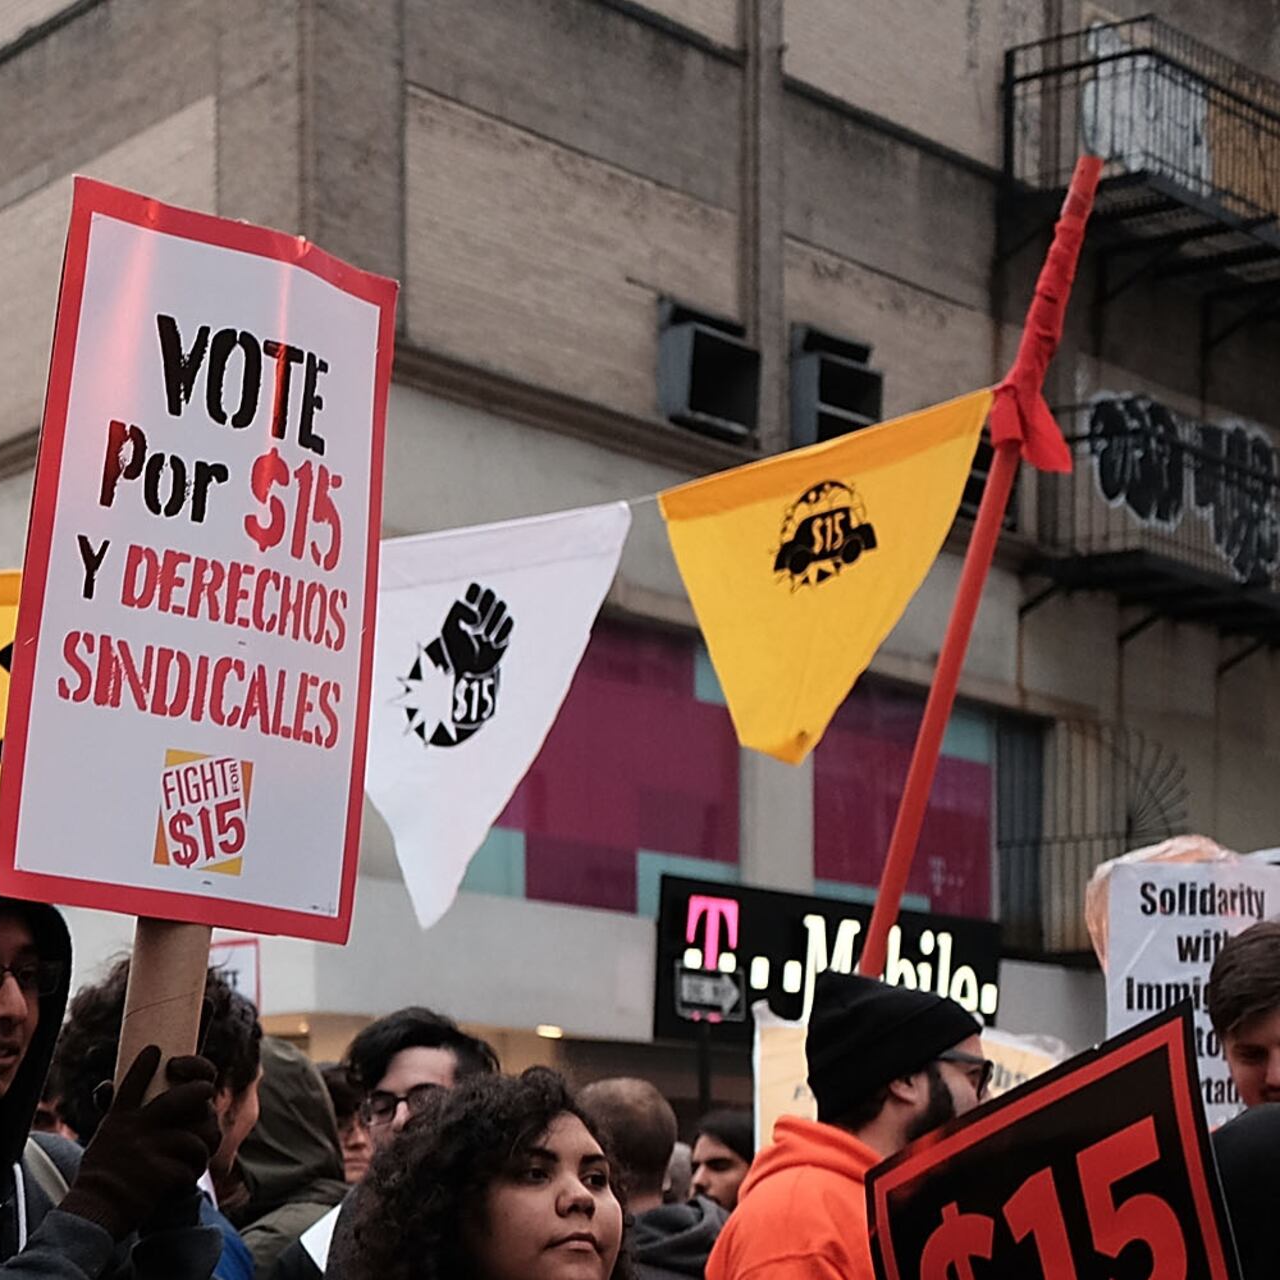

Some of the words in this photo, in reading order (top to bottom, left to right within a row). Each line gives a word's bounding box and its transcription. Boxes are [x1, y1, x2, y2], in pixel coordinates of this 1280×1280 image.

[156, 313, 330, 456] VOTE
[98, 420, 229, 524] Por
[244, 447, 344, 571] $15
[76, 534, 111, 601] Y
[121, 543, 349, 652] DERECHOS
[56, 631, 342, 751] SINDICALES
[162, 757, 236, 810] FIGHT
[228, 762, 241, 794] FOR
[168, 797, 246, 869] $15
[1139, 881, 1266, 920] Solidarity
